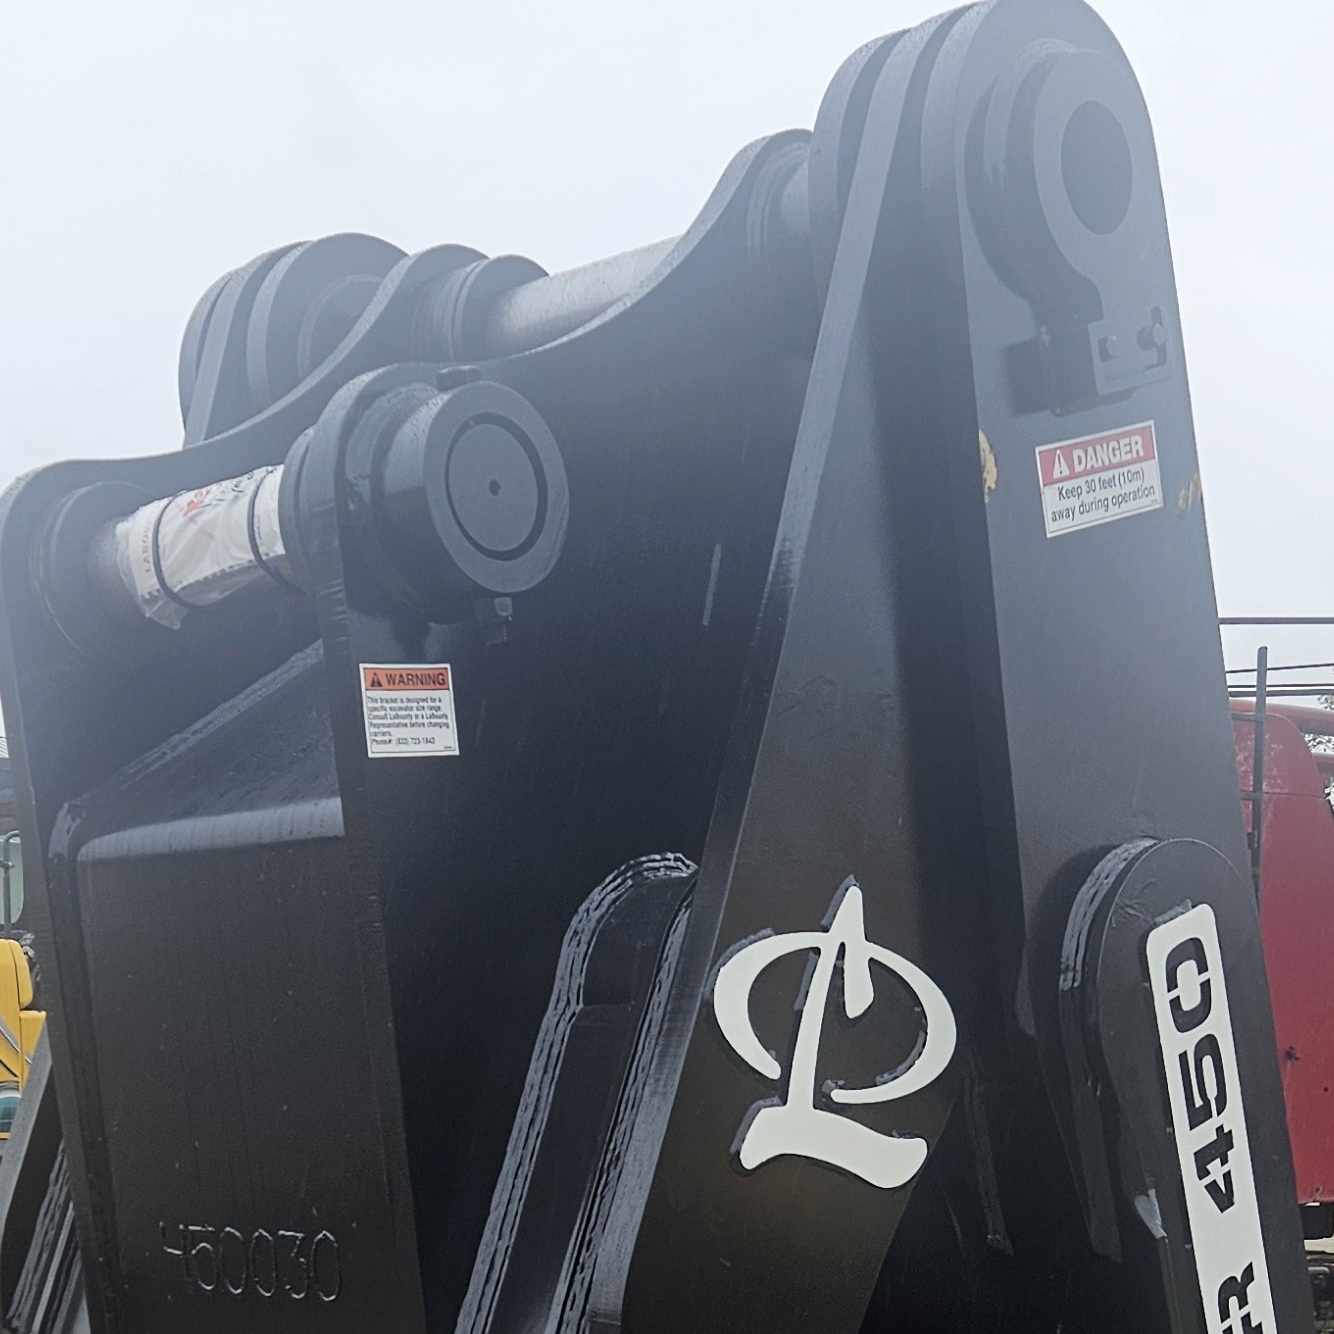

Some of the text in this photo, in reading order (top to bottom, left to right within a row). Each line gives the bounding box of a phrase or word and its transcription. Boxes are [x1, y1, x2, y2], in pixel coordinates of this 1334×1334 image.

[1073, 435, 1144, 473] DANGER
[1057, 466, 1145, 501] Keep 30 feet (10m)
[1051, 484, 1156, 522] away during operation
[386, 672, 446, 686] WARNING
[1166, 937, 1235, 1214] 450
